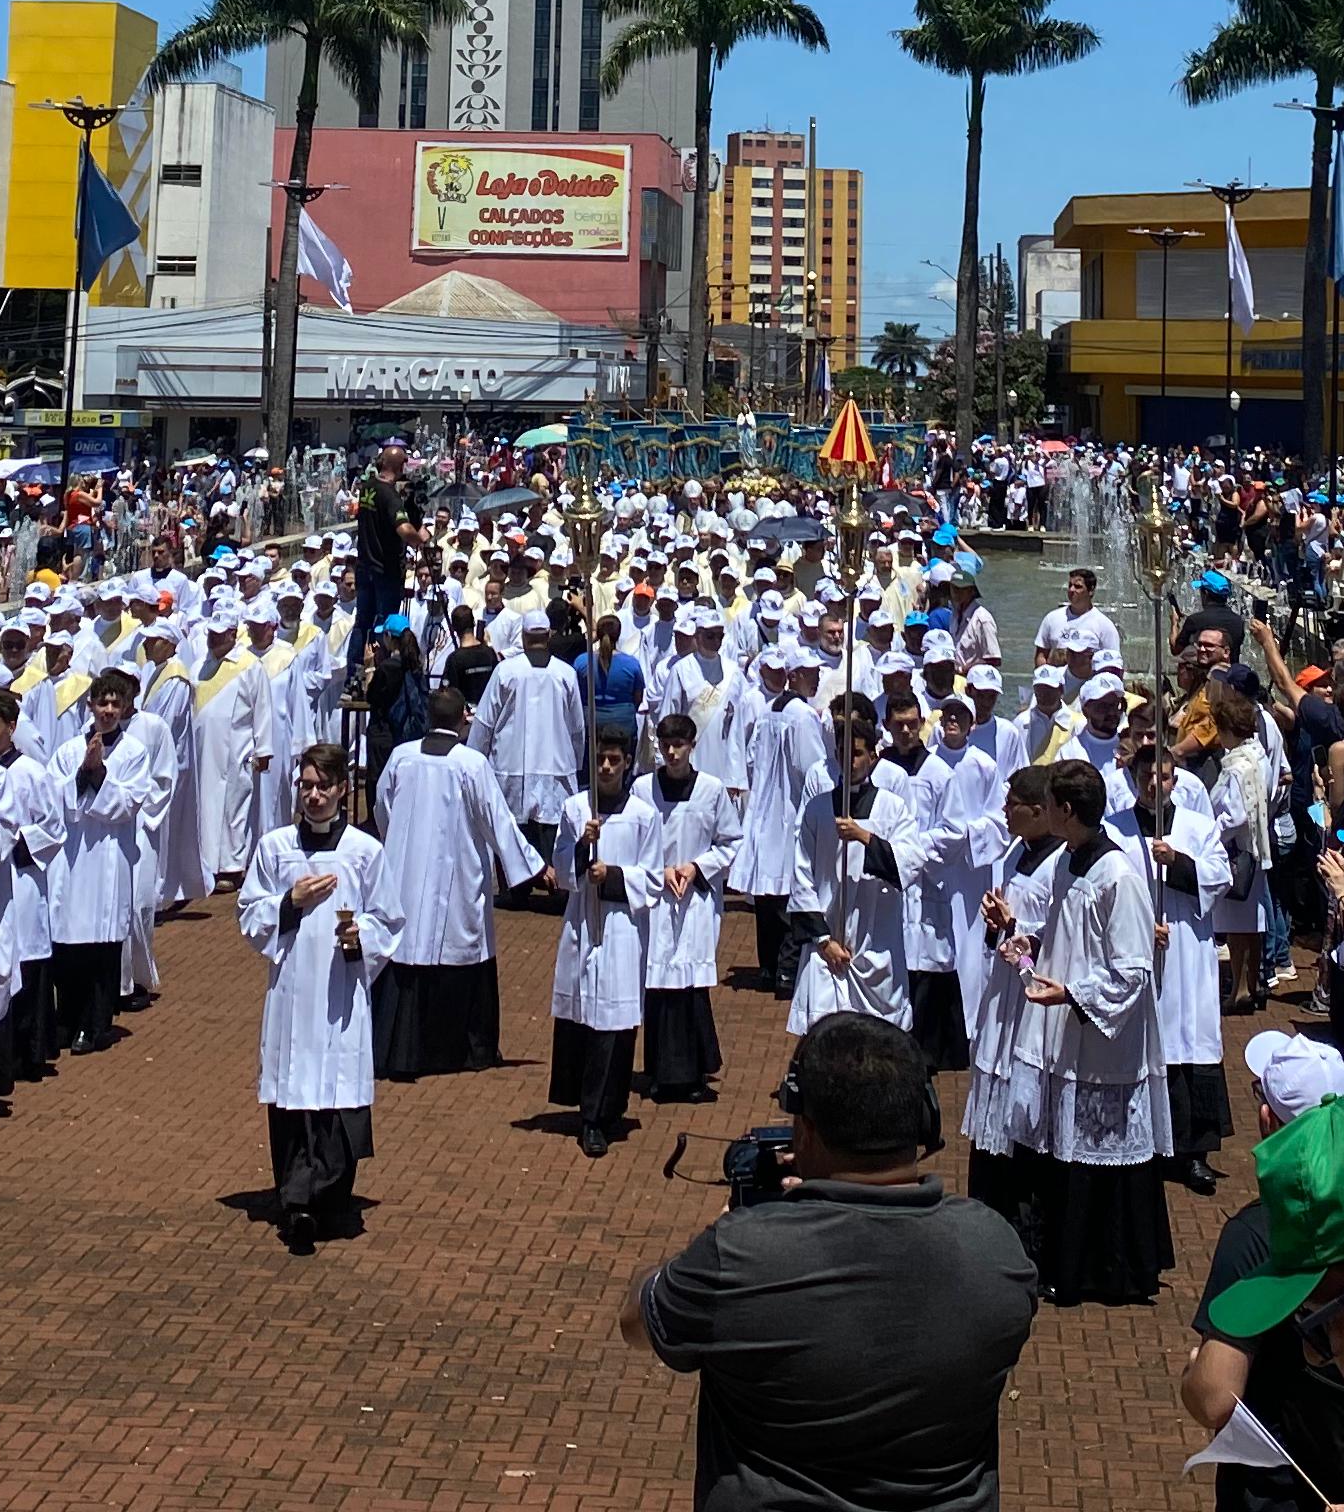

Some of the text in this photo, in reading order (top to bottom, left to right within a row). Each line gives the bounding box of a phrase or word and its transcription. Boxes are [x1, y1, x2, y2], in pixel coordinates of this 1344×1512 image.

[476, 170, 619, 199] Loja o Doidão
[479, 208, 565, 226] CALÇADOS
[468, 228, 574, 248] CONFECÇÕES
[326, 356, 505, 393] MARCATO
[74, 439, 108, 452] ÚNICA
